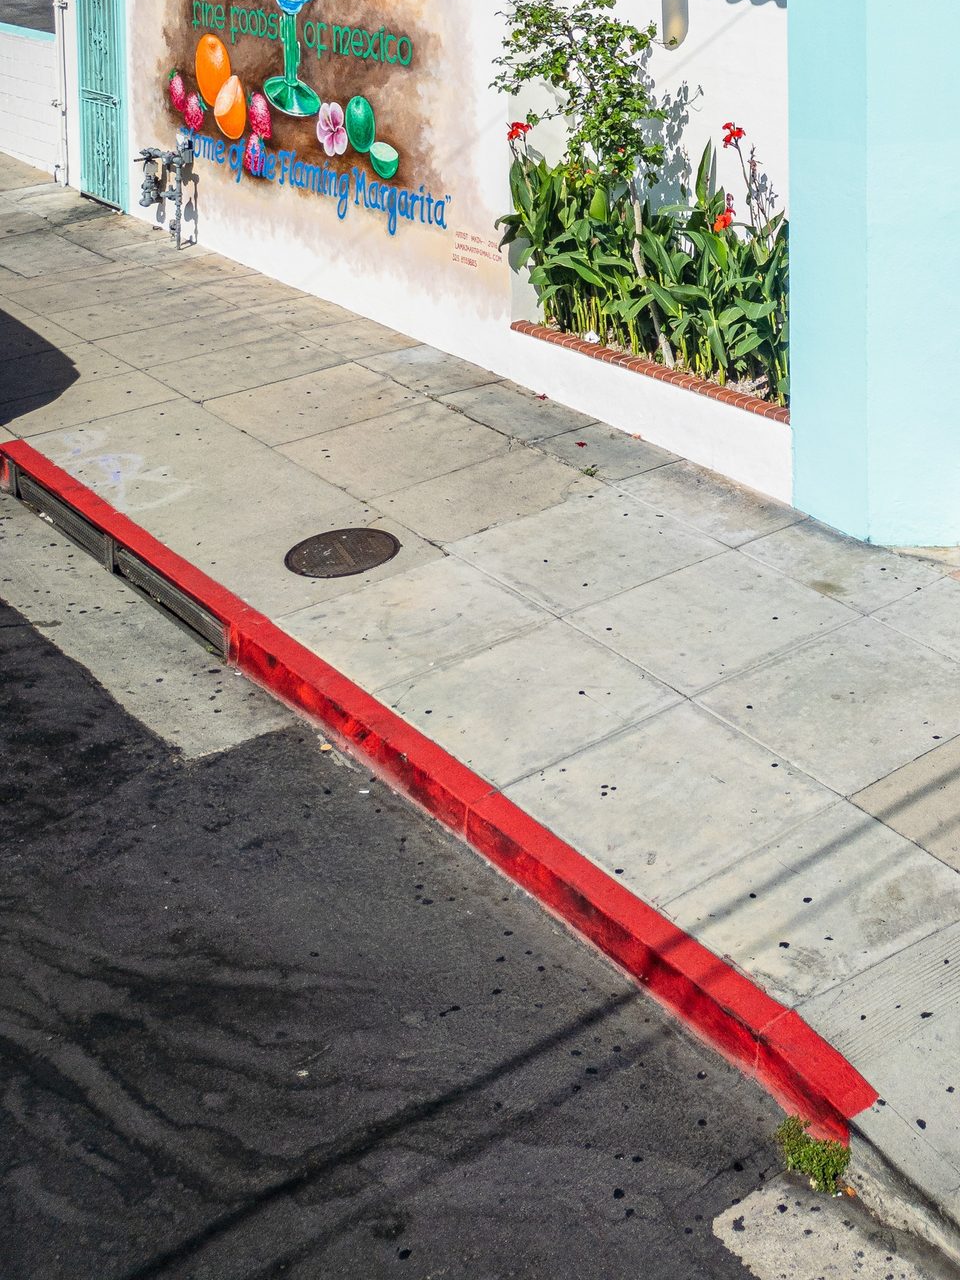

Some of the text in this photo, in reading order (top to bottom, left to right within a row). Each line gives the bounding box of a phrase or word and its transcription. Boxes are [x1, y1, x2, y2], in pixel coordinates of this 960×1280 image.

[304, 21, 328, 59] of
[332, 24, 413, 66] mexico
[229, 138, 246, 183] of
[250, 143, 276, 180] the
[278, 149, 349, 219] Flaming
